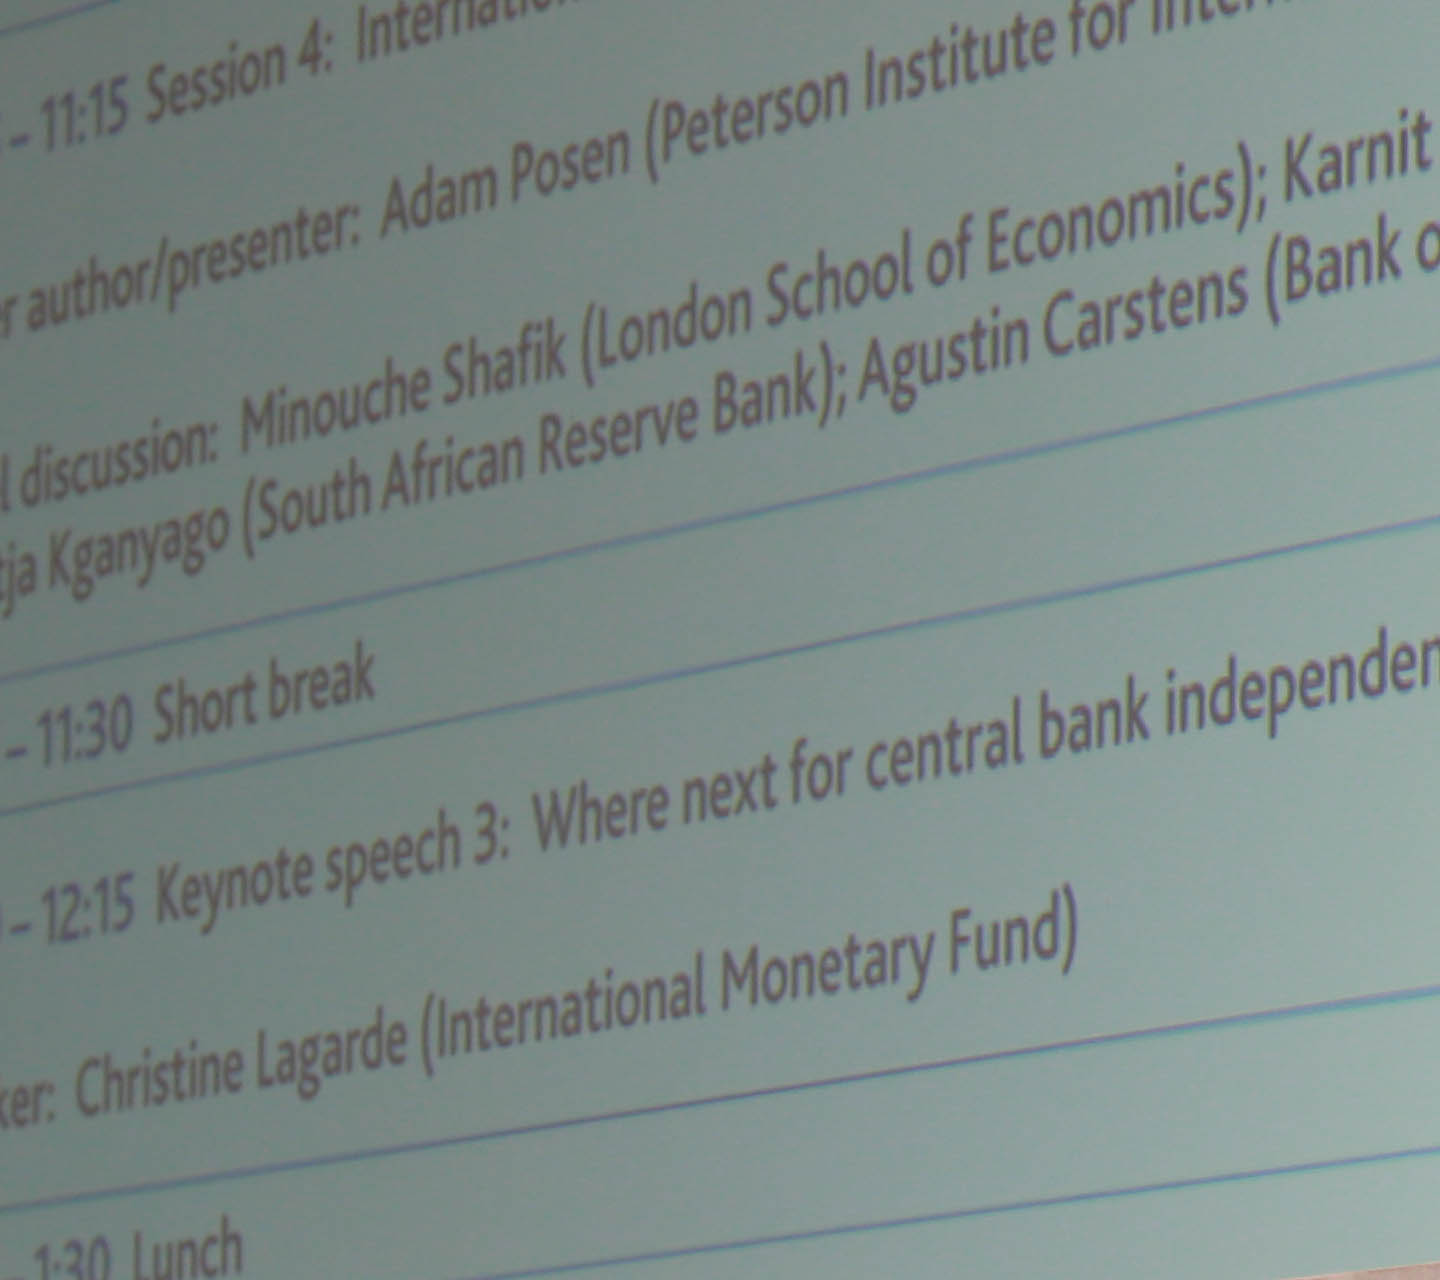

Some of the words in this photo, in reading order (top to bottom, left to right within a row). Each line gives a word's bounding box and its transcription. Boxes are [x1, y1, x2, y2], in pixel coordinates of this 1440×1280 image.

[26, 204, 361, 314] author/presenter:
[379, 163, 500, 239] Adam
[510, 129, 632, 204] Posen
[644, 70, 851, 186] (Peterson
[863, 12, 1059, 113] Institute
[1067, 0, 1138, 59] for
[40, 74, 130, 152] 11:15
[146, 41, 288, 126] Session
[296, 18, 334, 77] 4:
[19, 417, 219, 509] discussion:
[240, 356, 433, 454] Minouche
[442, 316, 567, 407] Shafik
[580, 280, 754, 389] (London
[765, 227, 916, 330] School
[925, 211, 976, 290] of
[986, 139, 1269, 276] Economics);
[1282, 106, 1435, 205] Karnit
[48, 507, 232, 604] Kganyago
[241, 458, 373, 560] (South
[380, 435, 526, 512] African
[538, 395, 701, 476] Reserve
[712, 339, 848, 437] Bank);
[856, 304, 1031, 417] Agustin
[1041, 264, 1251, 360] Carstens
[1263, 211, 1404, 330] (Bank
[36, 692, 135, 767] 11:30
[153, 673, 259, 746] Short
[267, 638, 377, 722] break
[41, 870, 136, 945] 12:15
[156, 848, 316, 937] Keynote
[324, 807, 463, 910] speech
[473, 800, 511, 867] 3:
[530, 778, 672, 854] Where
[681, 752, 780, 826] next
[787, 736, 856, 807] for
[864, 694, 1027, 794] central
[1037, 672, 1153, 762] bank
[74, 1039, 246, 1119] Christine
[256, 1004, 409, 1103] Lagarde
[420, 949, 709, 1079] (International
[719, 930, 938, 1013] Monetary
[948, 880, 1080, 978] Fund)
